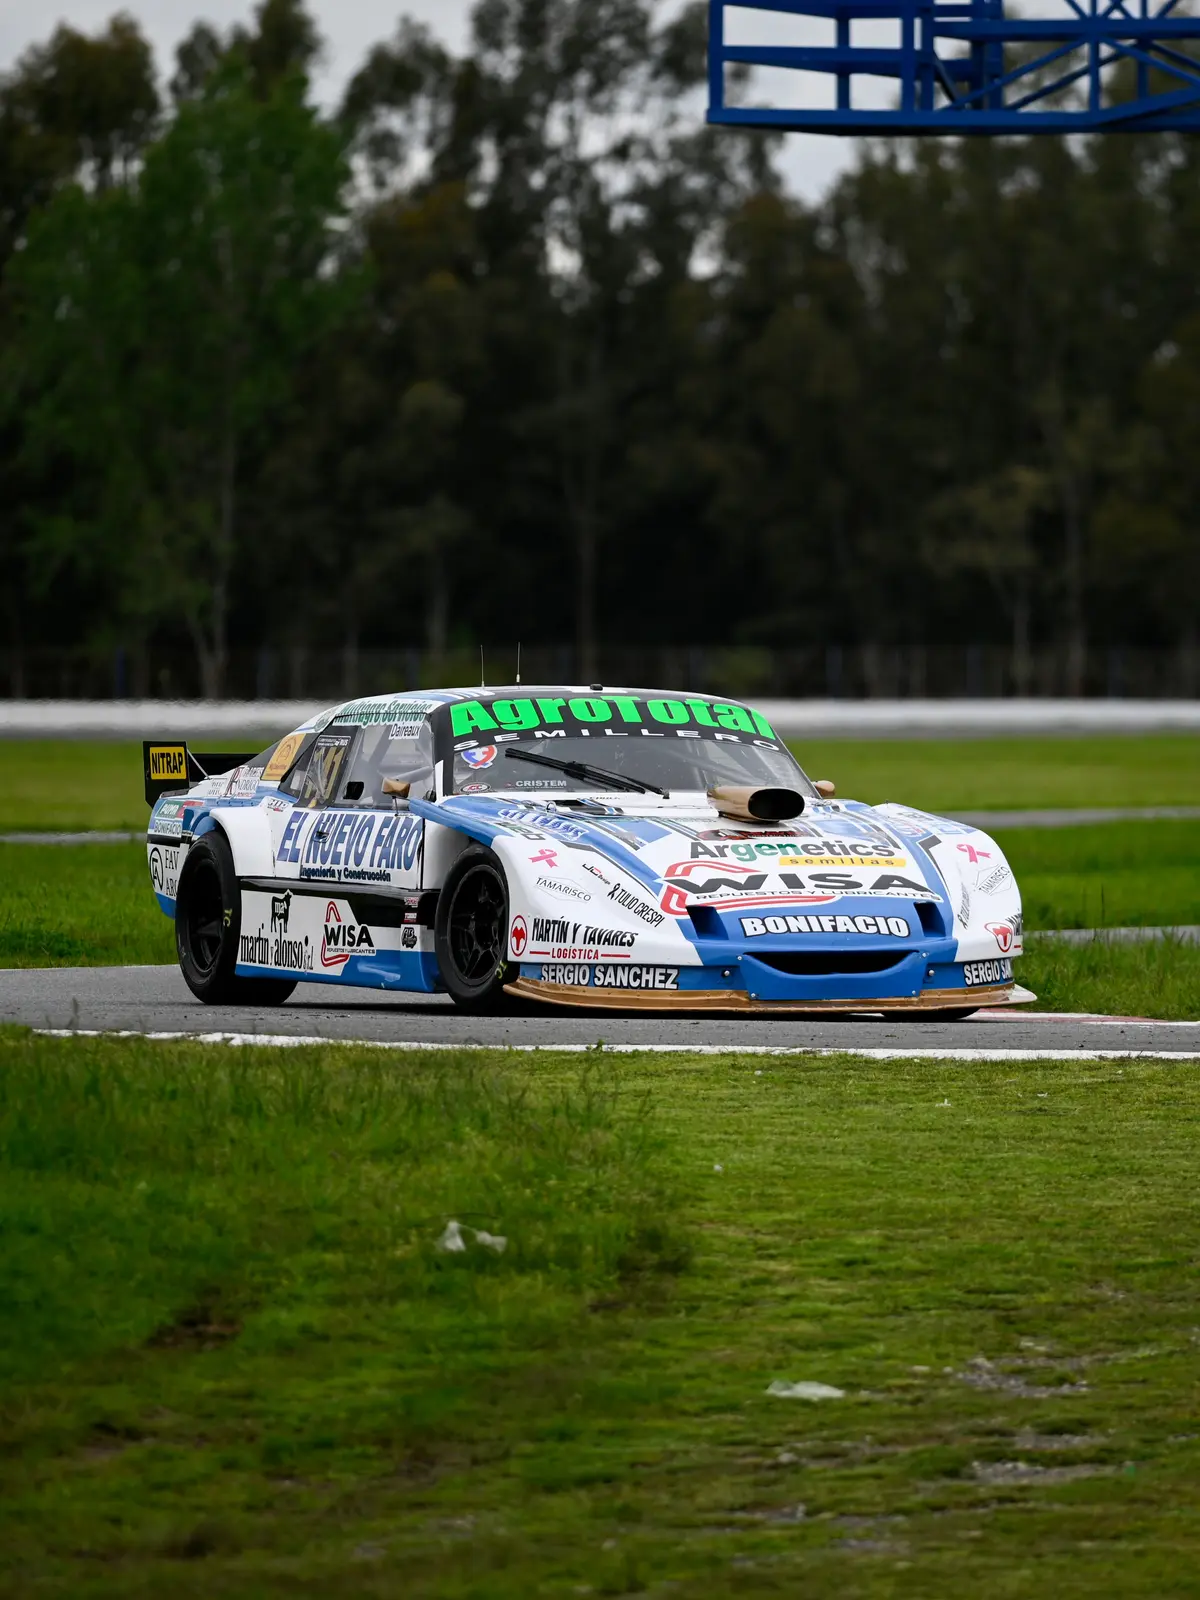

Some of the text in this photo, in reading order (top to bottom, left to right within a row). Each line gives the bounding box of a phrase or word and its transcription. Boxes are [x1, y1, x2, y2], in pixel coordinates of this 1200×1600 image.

[390, 722, 420, 737] Daireaux
[450, 696, 776, 740] AgroTotal
[454, 728, 779, 751] SEMILLERO
[151, 752, 183, 774] NITRAP
[277, 811, 423, 871] EL NUEVO FARO
[690, 840, 895, 861] Argenetics
[165, 849, 179, 870] FAV
[790, 857, 894, 866] semillas
[300, 865, 391, 882] Ingeniería y Construcción
[666, 873, 938, 894] WISA
[535, 877, 592, 901] TAMARISCO
[696, 890, 802, 899] REPUESTOS
[821, 890, 942, 900] LUBRICANTES
[615, 889, 666, 928] TULIO CRESPI
[324, 924, 374, 947] WISA
[531, 916, 639, 948] MARTÍN Y TAVARES
[739, 915, 911, 938] BONIFACIO
[240, 923, 269, 964] martin
[274, 922, 303, 969] alonso
[551, 946, 599, 960] LOGÍSTICA
[540, 964, 679, 989] SERGIO SANCHEZ
[964, 961, 1000, 986] SERGIO
